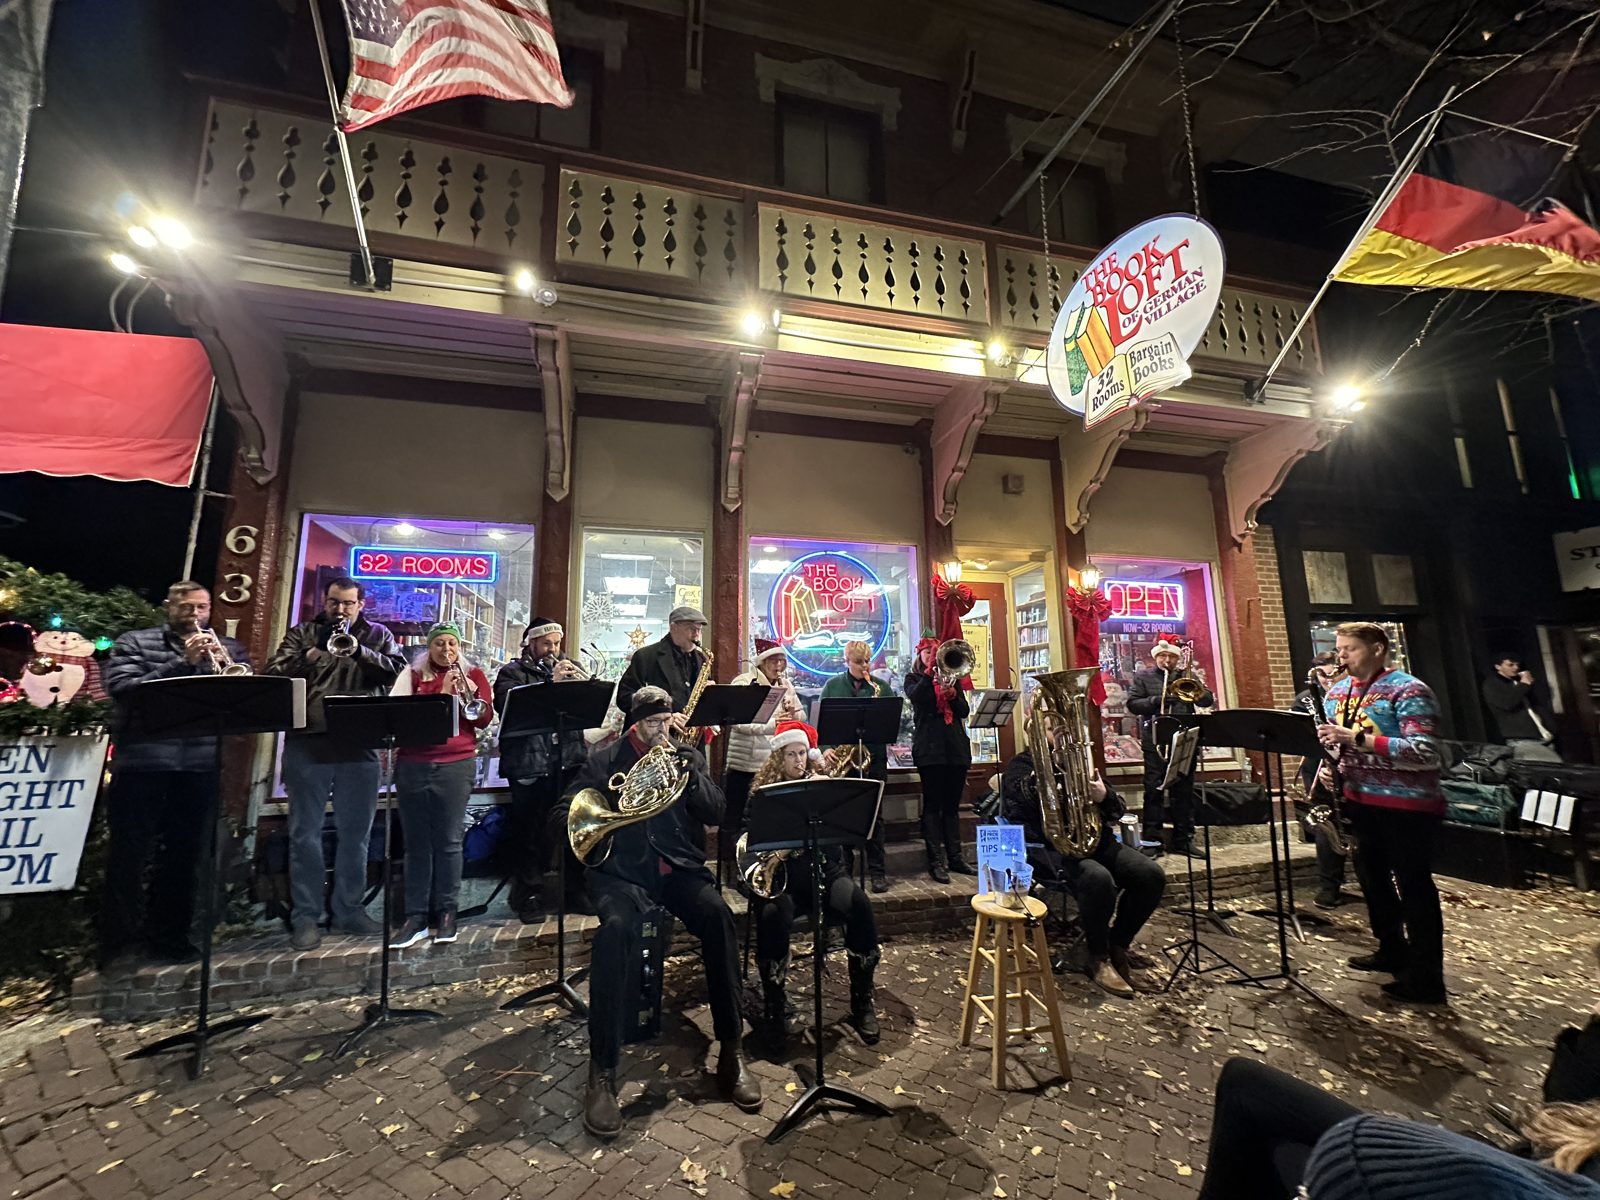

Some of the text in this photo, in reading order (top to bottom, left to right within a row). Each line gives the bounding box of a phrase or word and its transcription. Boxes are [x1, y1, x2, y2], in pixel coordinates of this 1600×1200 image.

[1081, 252, 1122, 293] THE
[1091, 234, 1167, 307] BOOK
[1100, 239, 1190, 347] LOFT
[1122, 265, 1204, 329] OF GERMAN
[1144, 279, 1206, 325] VILLAGE
[1129, 340, 1173, 369] Bargain
[1133, 356, 1175, 383] Books
[1092, 377, 1125, 412] Rooms
[1096, 365, 1114, 395] 32
[358, 553, 488, 576] 32 ROOMS
[803, 563, 837, 577] THE
[813, 577, 862, 592] BOOK
[1108, 584, 1181, 618] OPEN
[820, 592, 877, 627] LOFT
[981, 844, 998, 853] TIPS
